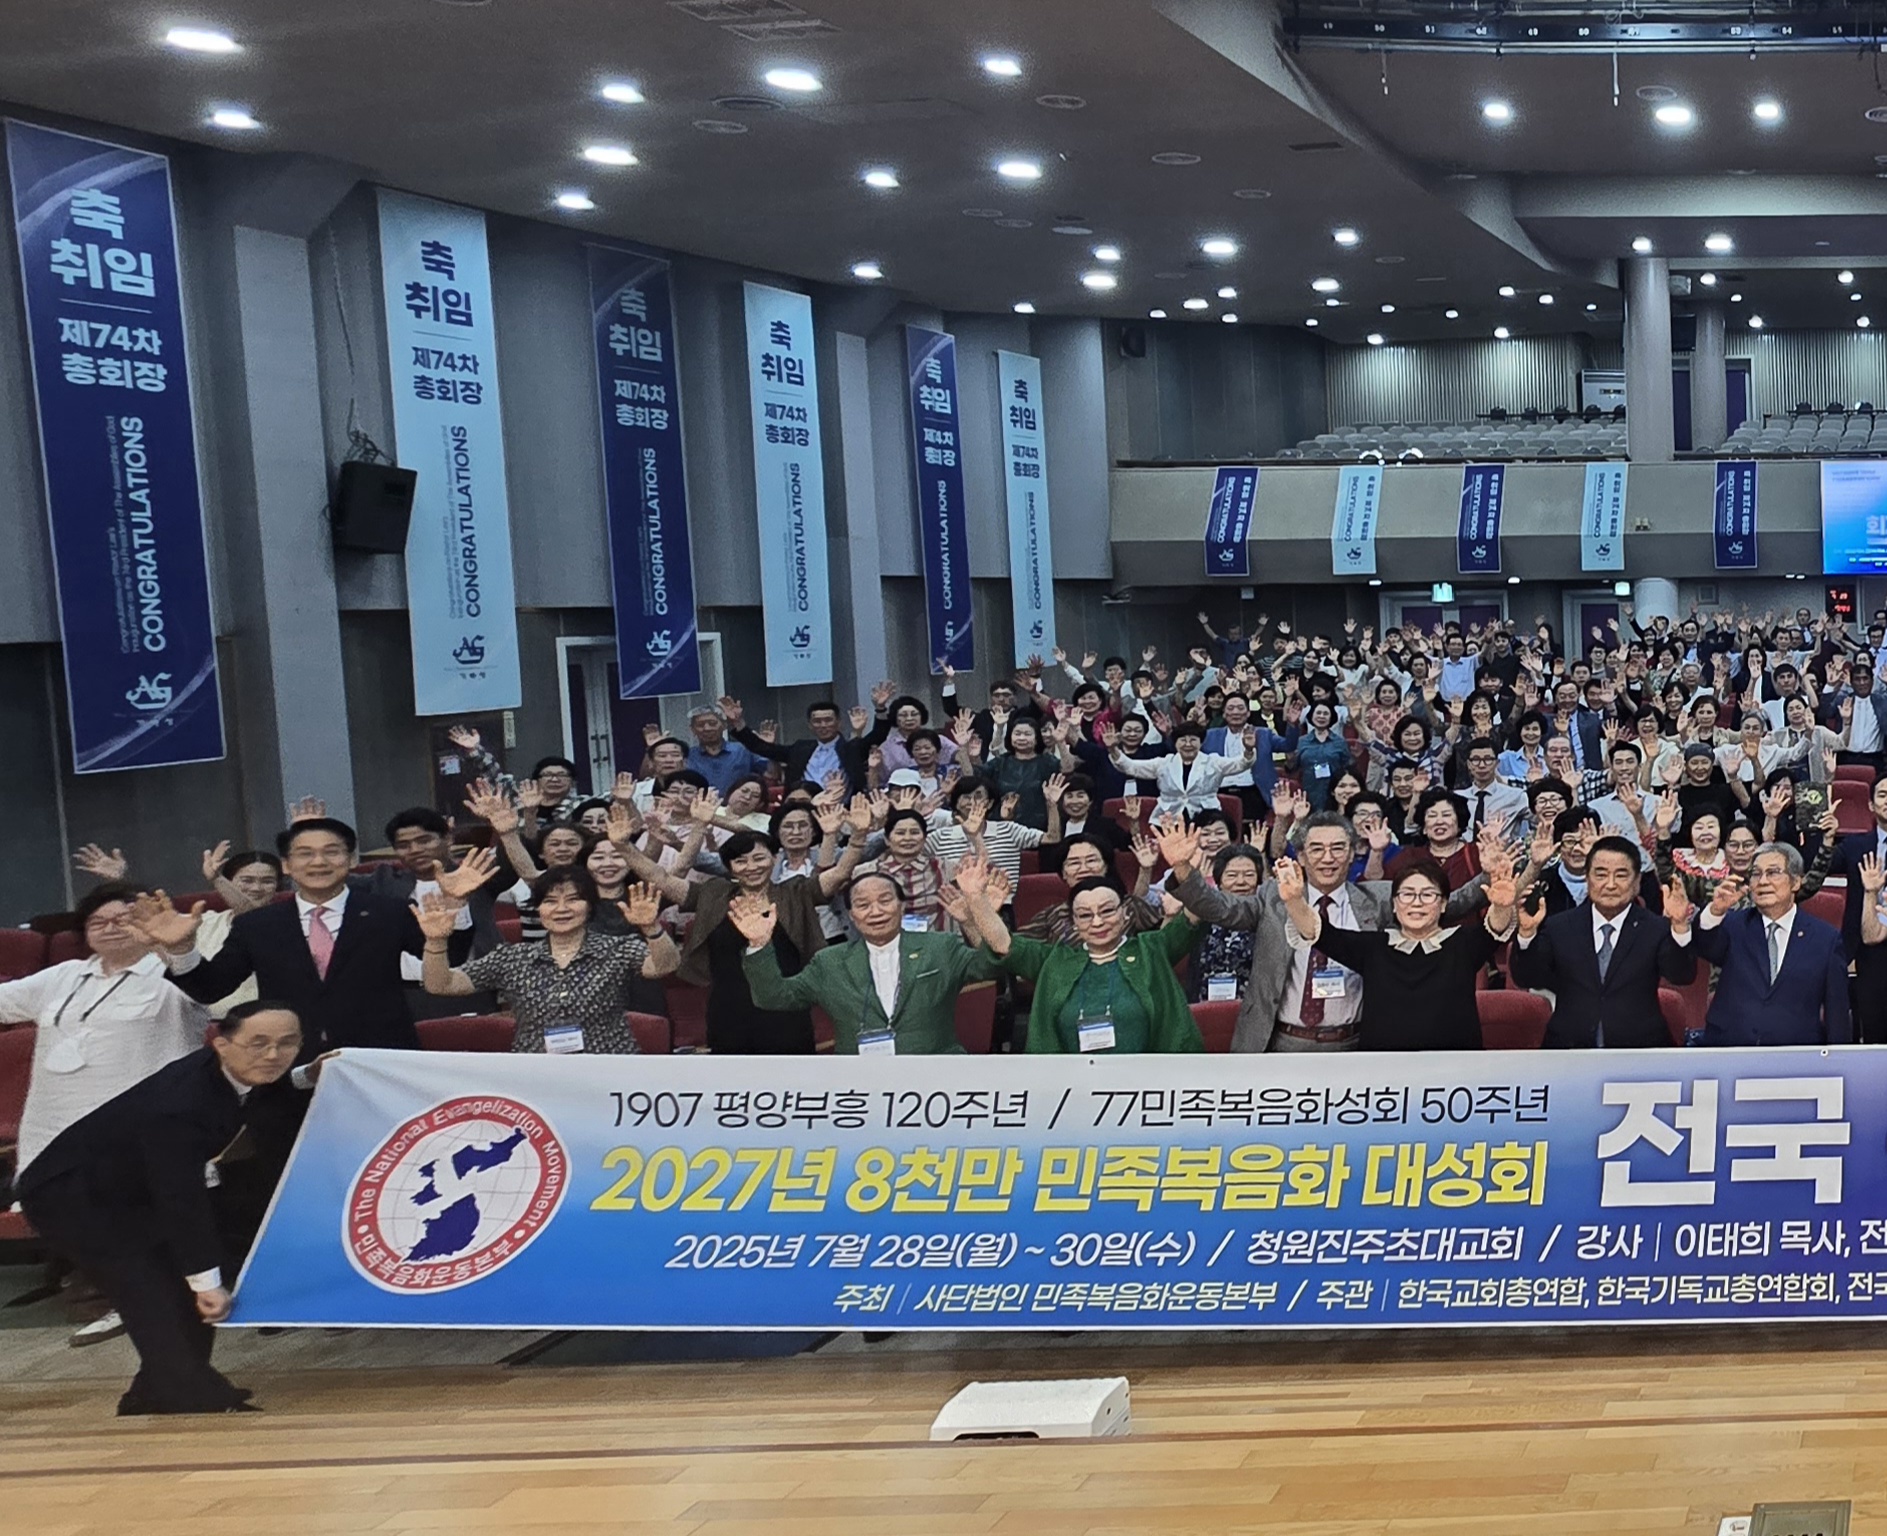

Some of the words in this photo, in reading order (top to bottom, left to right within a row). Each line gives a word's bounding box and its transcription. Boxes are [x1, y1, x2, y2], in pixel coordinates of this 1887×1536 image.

[70, 190, 123, 238] 축
[50, 239, 155, 297] 취임
[420, 240, 455, 281] 축
[405, 283, 473, 327] 취임
[620, 288, 646, 323] 축
[59, 317, 162, 355] 제74차
[609, 324, 663, 362] 취임
[770, 321, 792, 351] 축
[61, 354, 167, 393] 총회장
[412, 347, 479, 375] 제74차
[761, 355, 804, 387] 취임
[413, 374, 482, 405] 총회장
[614, 379, 665, 404] 제74차
[920, 385, 951, 414] 취임
[1014, 379, 1028, 402] 축
[616, 404, 668, 430] 총회장
[764, 402, 807, 424] 제74차
[1010, 406, 1036, 431] 취임
[765, 424, 809, 446] 총회장
[120, 416, 166, 652] CONGRATULATIONS
[451, 426, 481, 617] CONGRATULATIONS
[643, 448, 668, 615] CONGRATULATIONS
[790, 463, 808, 611] CONGRATULATIONS
[937, 480, 952, 609] CONGRATULATIONS
[1028, 492, 1042, 610] CONGRATULATIONS
[432, 1100, 544, 1140] Evangelization
[610, 1092, 703, 1127] 1907
[714, 1090, 869, 1129] 평양부흥
[883, 1091, 1028, 1129] 120주년
[1092, 1087, 1409, 1126] 77민족복음화성회
[1421, 1085, 1549, 1124] 50주년
[364, 1119, 429, 1183] National
[1596, 1075, 1852, 1207] 전국
[523, 1140, 562, 1228] Movement
[590, 1147, 832, 1213] 2027년
[845, 1146, 1022, 1214] 8천만
[1034, 1142, 1350, 1212] 민족복음화
[1361, 1140, 1548, 1209] 대성회
[354, 1188, 377, 1221] The
[354, 1231, 514, 1287] 민족복음화운동본부
[665, 1235, 802, 1268] 2025년
[808, 1234, 871, 1267] 7월
[870, 1233, 1017, 1267] 28일(월)
[1051, 1231, 1195, 1266] 30일(수)
[1248, 1226, 1524, 1264] 청원진주초대교회
[1578, 1224, 1643, 1259] 강사
[1676, 1222, 1770, 1257] 이태희
[1780, 1220, 1850, 1257] 목사,
[834, 1284, 895, 1312] 주최
[914, 1284, 1029, 1311] 사단법인
[1032, 1282, 1277, 1311] 민족복음화운동본부
[1317, 1280, 1373, 1310] 주관
[1399, 1277, 1589, 1308] 한국교회총연합,
[1598, 1273, 1840, 1305] 한국기독교총연합회,
